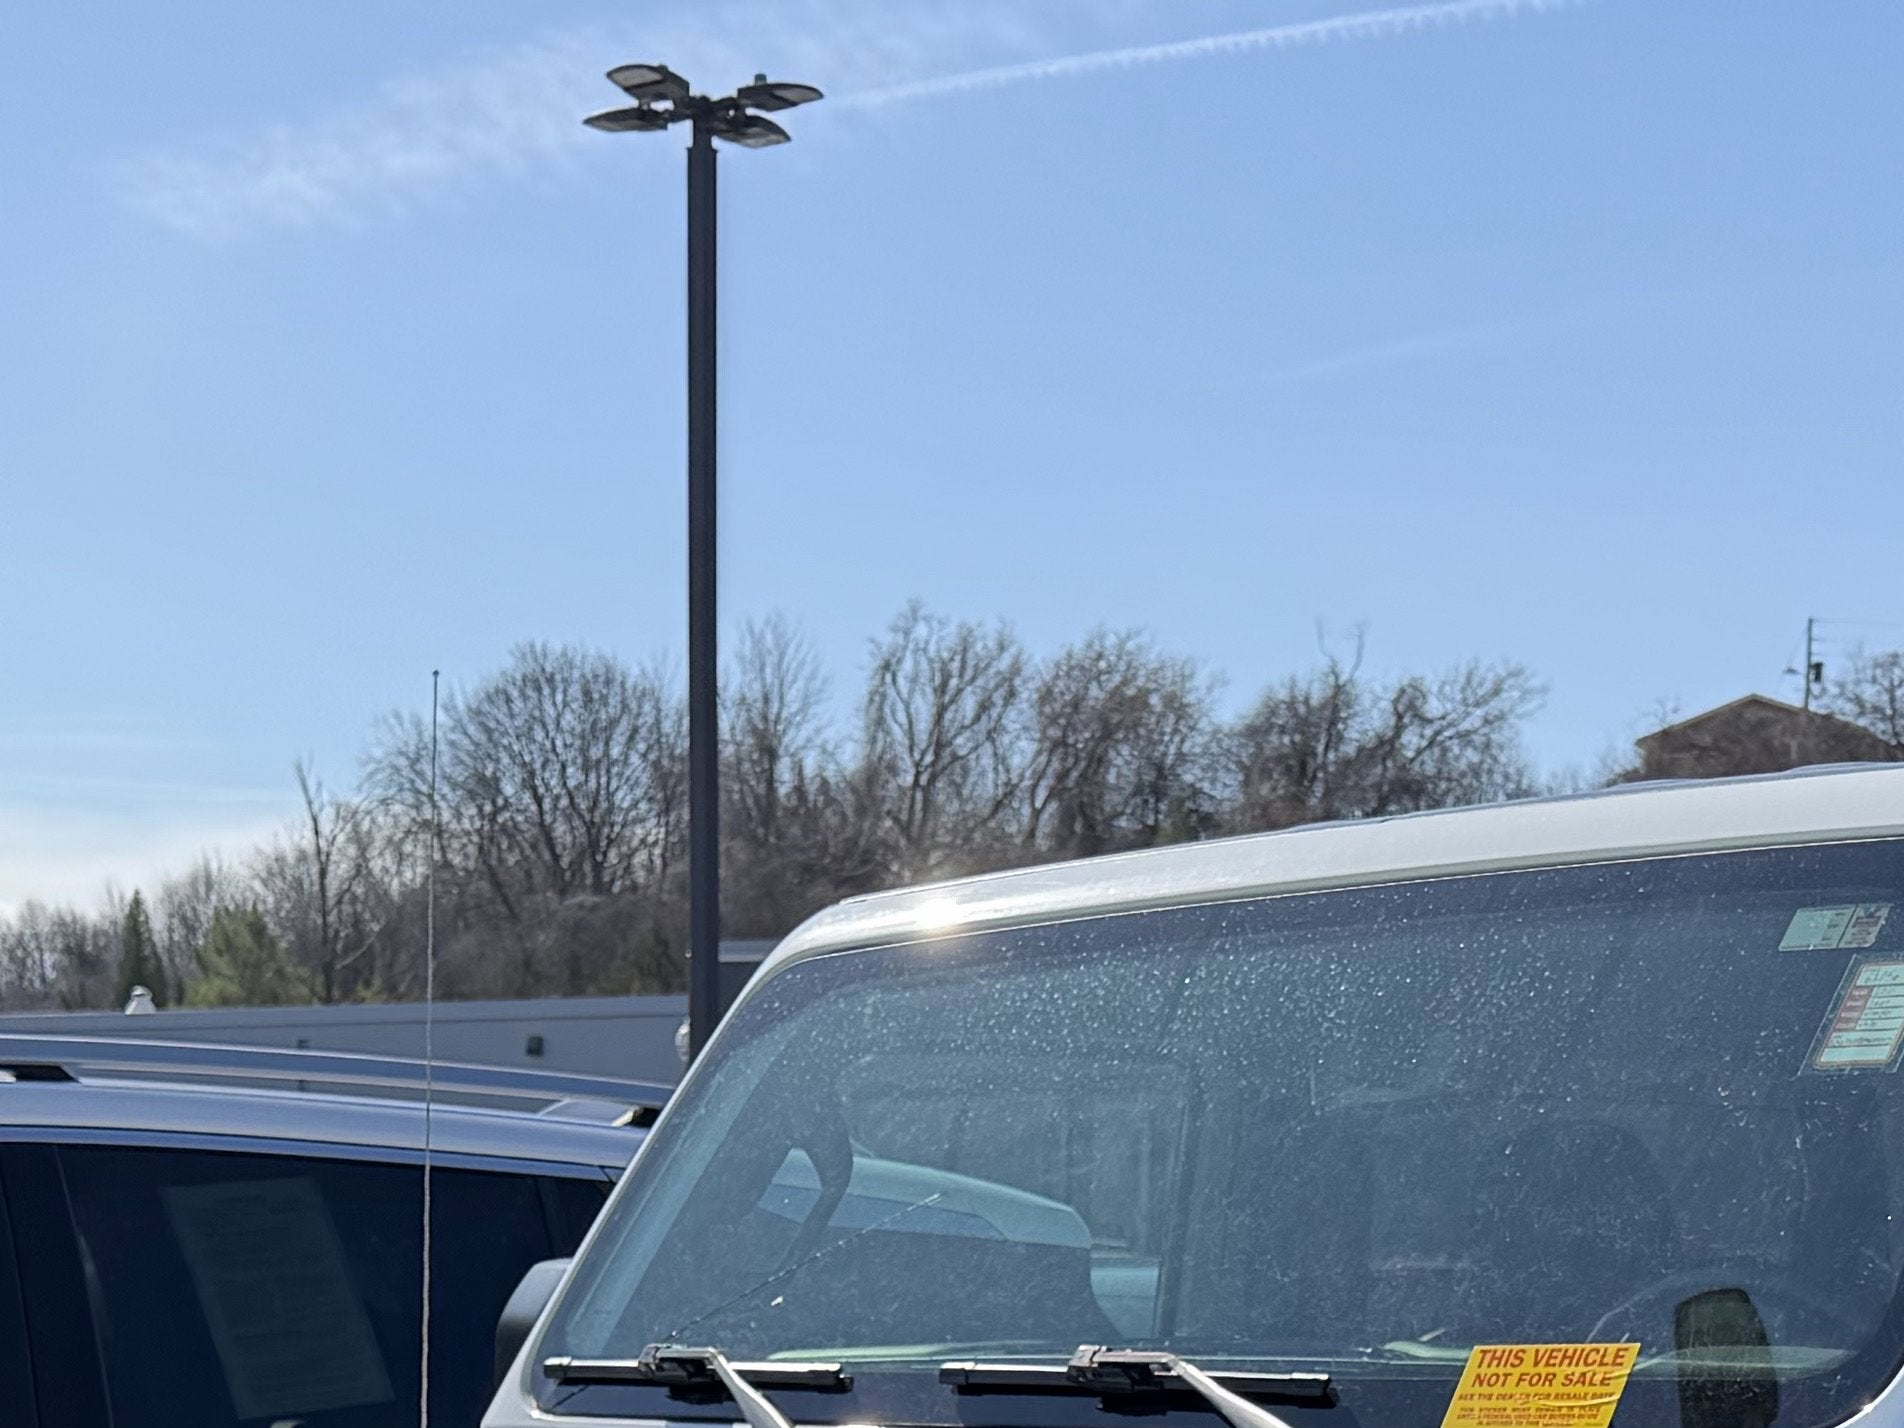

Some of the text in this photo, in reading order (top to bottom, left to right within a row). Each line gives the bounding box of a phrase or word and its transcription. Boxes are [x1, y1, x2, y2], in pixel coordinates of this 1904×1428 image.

[1477, 1346, 1630, 1369] THIS VEHICLE
[1472, 1370, 1616, 1388] NOT FOR SALE
